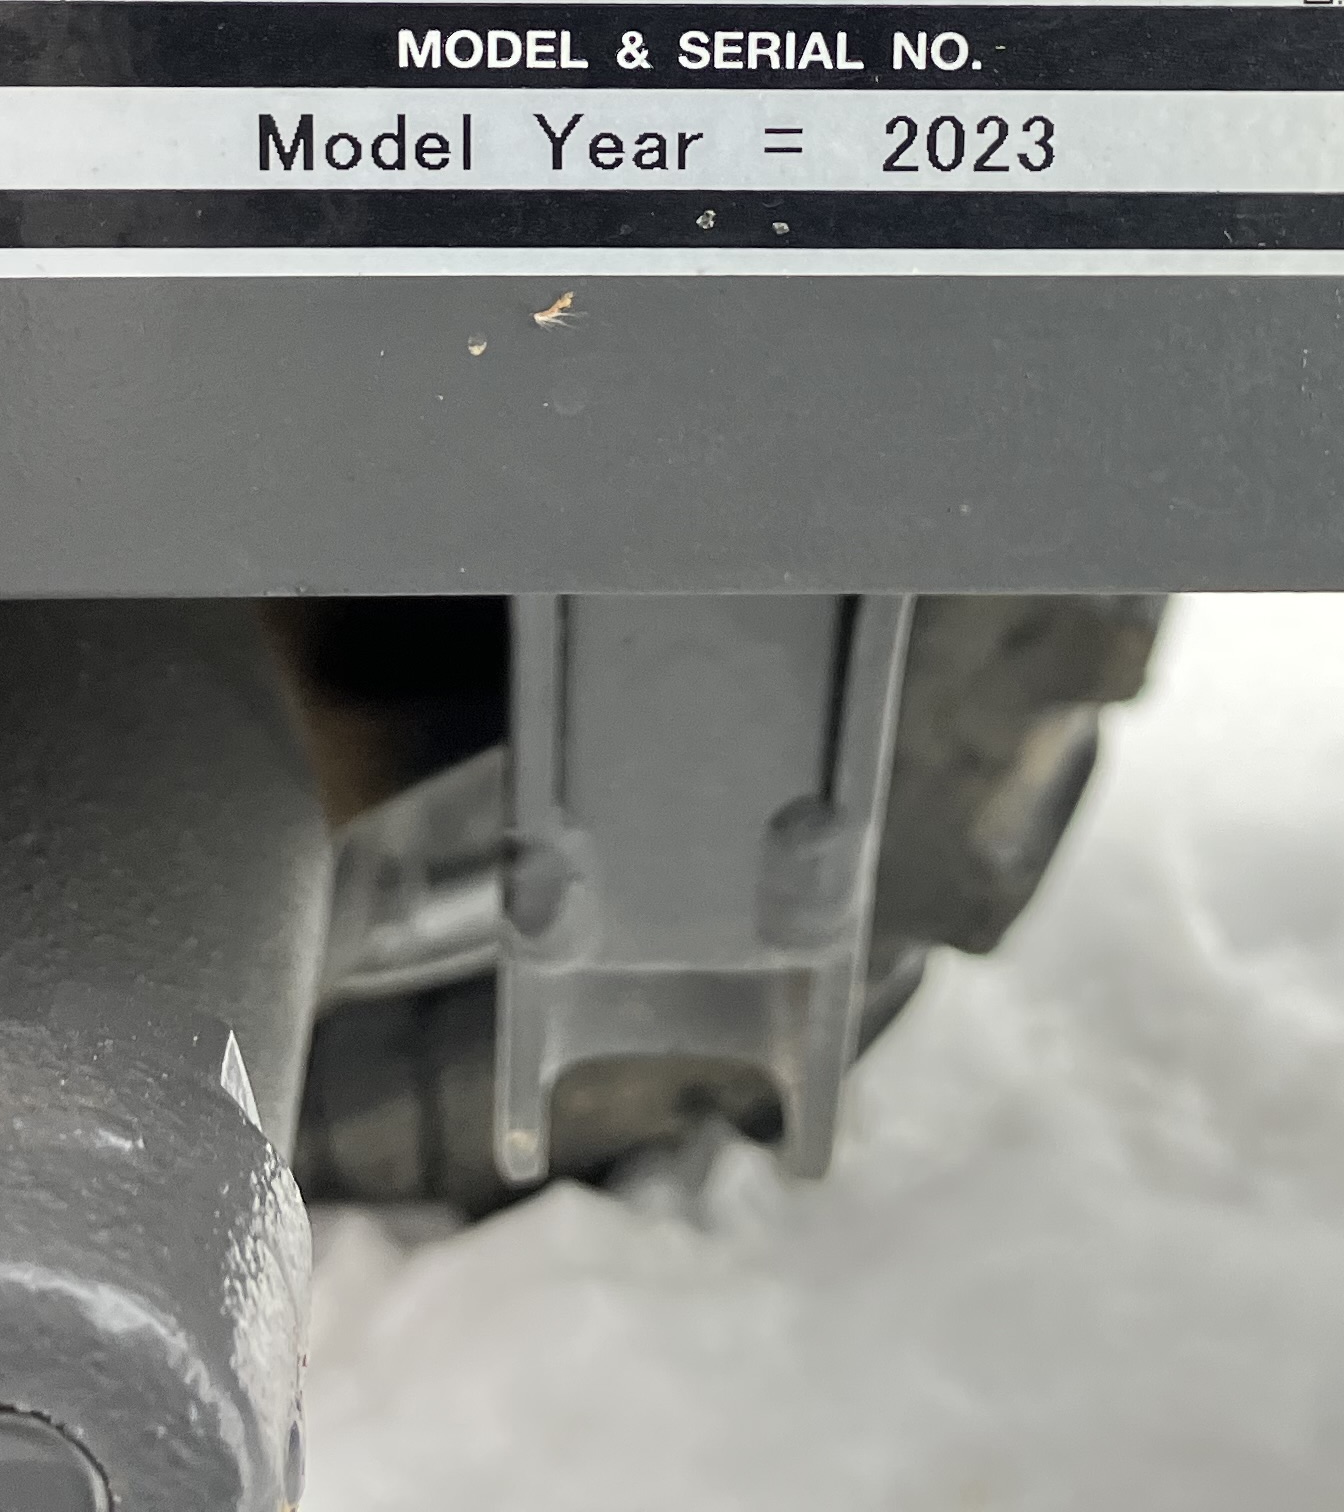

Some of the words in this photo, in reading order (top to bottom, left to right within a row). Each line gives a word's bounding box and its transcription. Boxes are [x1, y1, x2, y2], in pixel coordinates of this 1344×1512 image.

[398, 29, 589, 69] MODEL
[616, 30, 652, 70] &
[678, 30, 863, 70] SERIAL
[892, 31, 982, 71] NO.
[258, 113, 472, 171] Model
[533, 113, 704, 171] Year
[763, 127, 804, 154] =
[882, 115, 1055, 172] 2023
